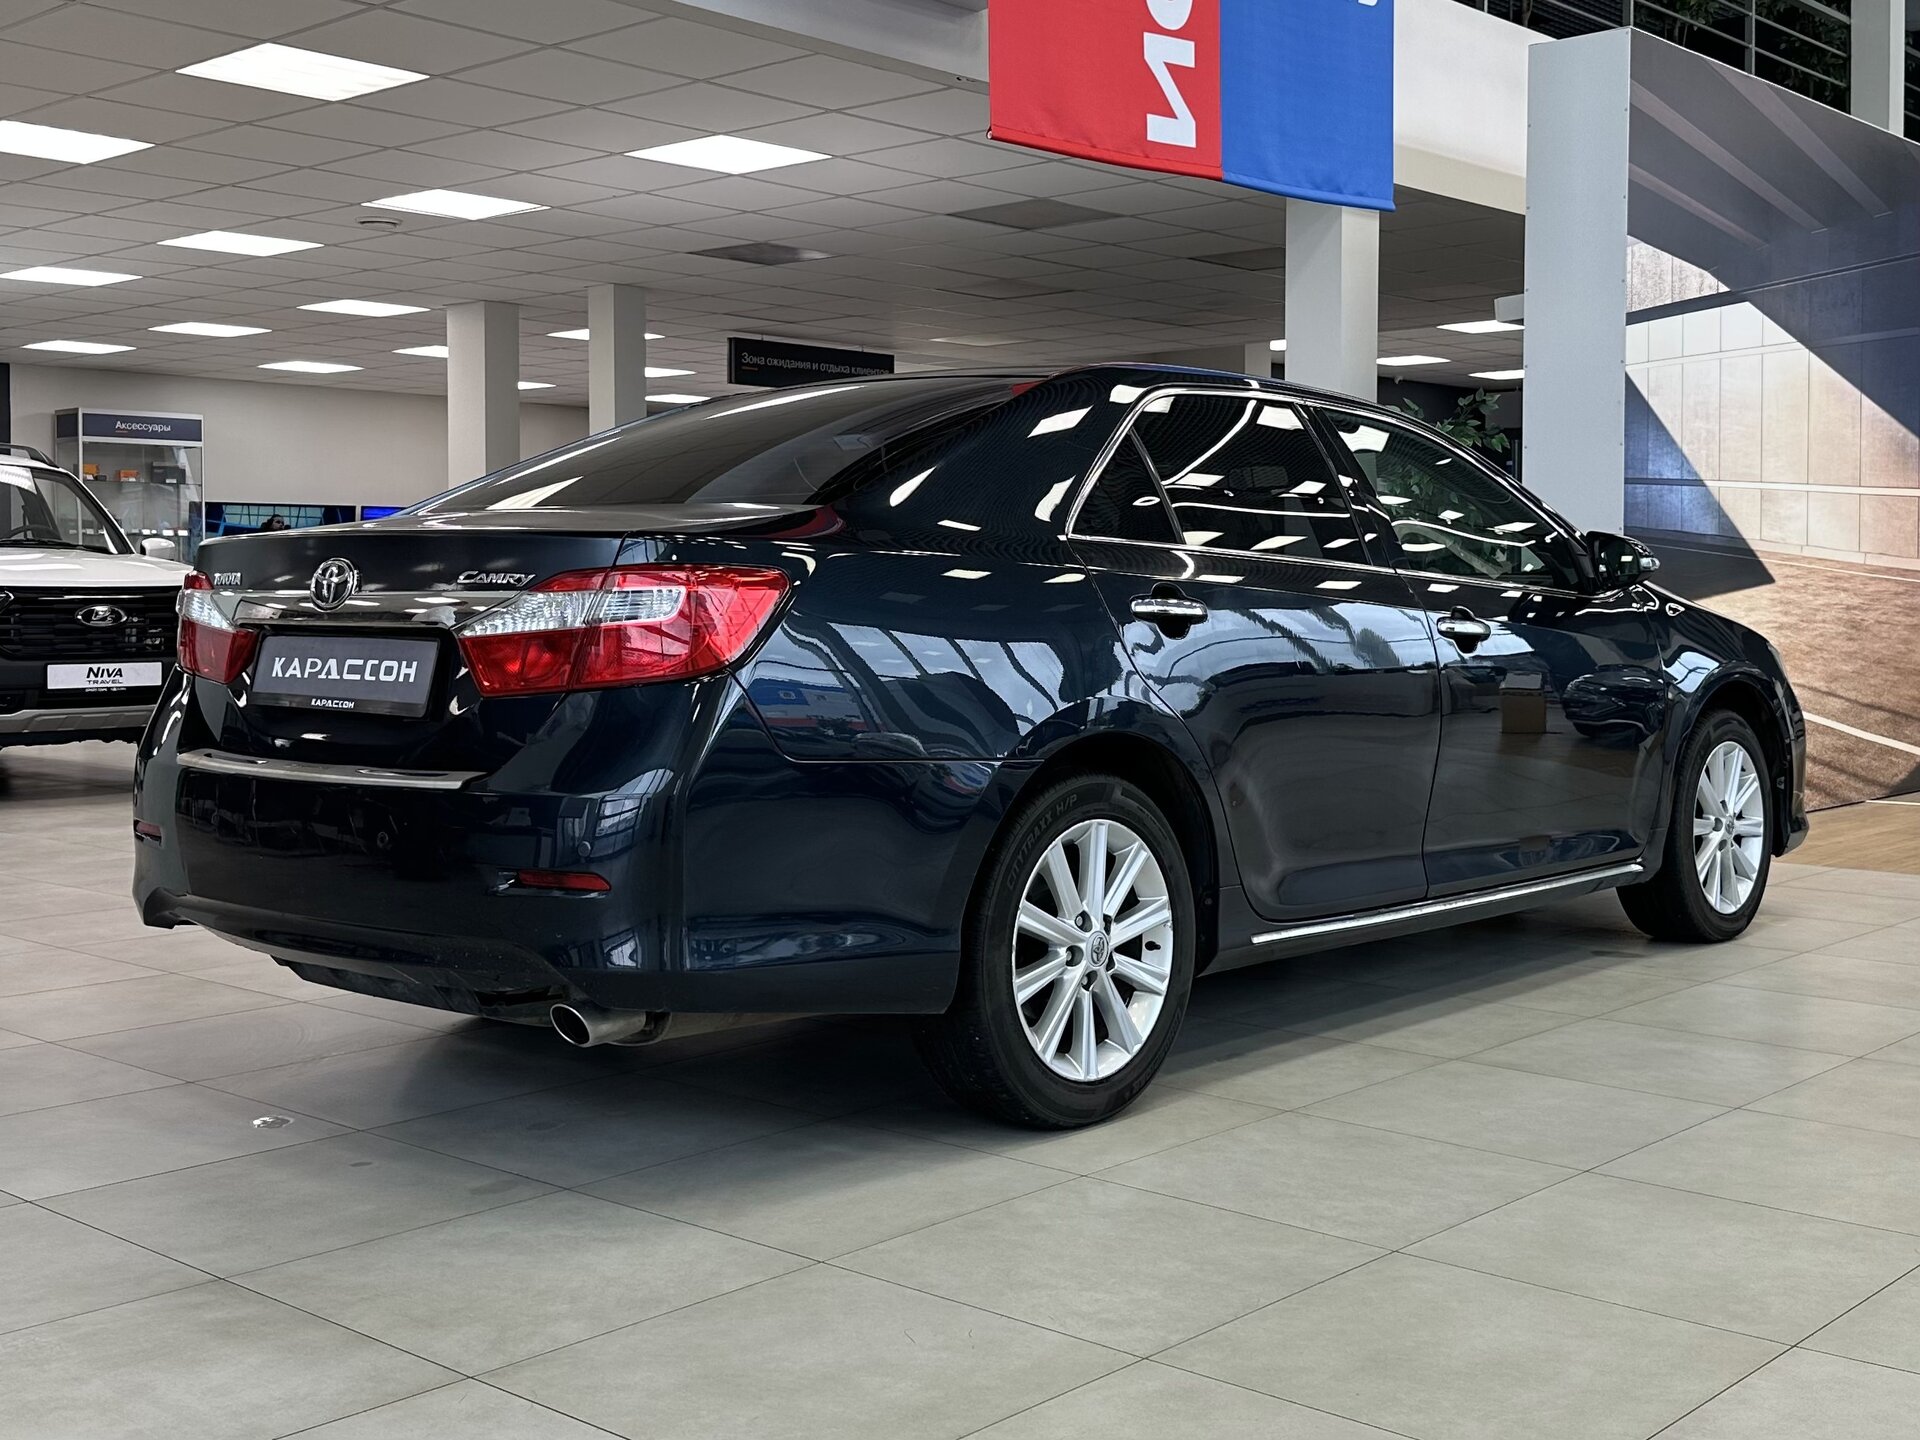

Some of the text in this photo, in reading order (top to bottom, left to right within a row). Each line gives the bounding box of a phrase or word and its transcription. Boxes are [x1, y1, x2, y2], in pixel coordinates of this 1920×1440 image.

[741, 352, 765, 365] Зона
[766, 357, 811, 369] ожидания
[812, 362, 819, 370] и
[820, 363, 850, 374] отдыха
[115, 421, 171, 432] Аксессуары
[272, 657, 418, 683] КАРАССОН
[311, 698, 355, 709] КАРАССОН
[1056, 793, 1077, 815] H/P
